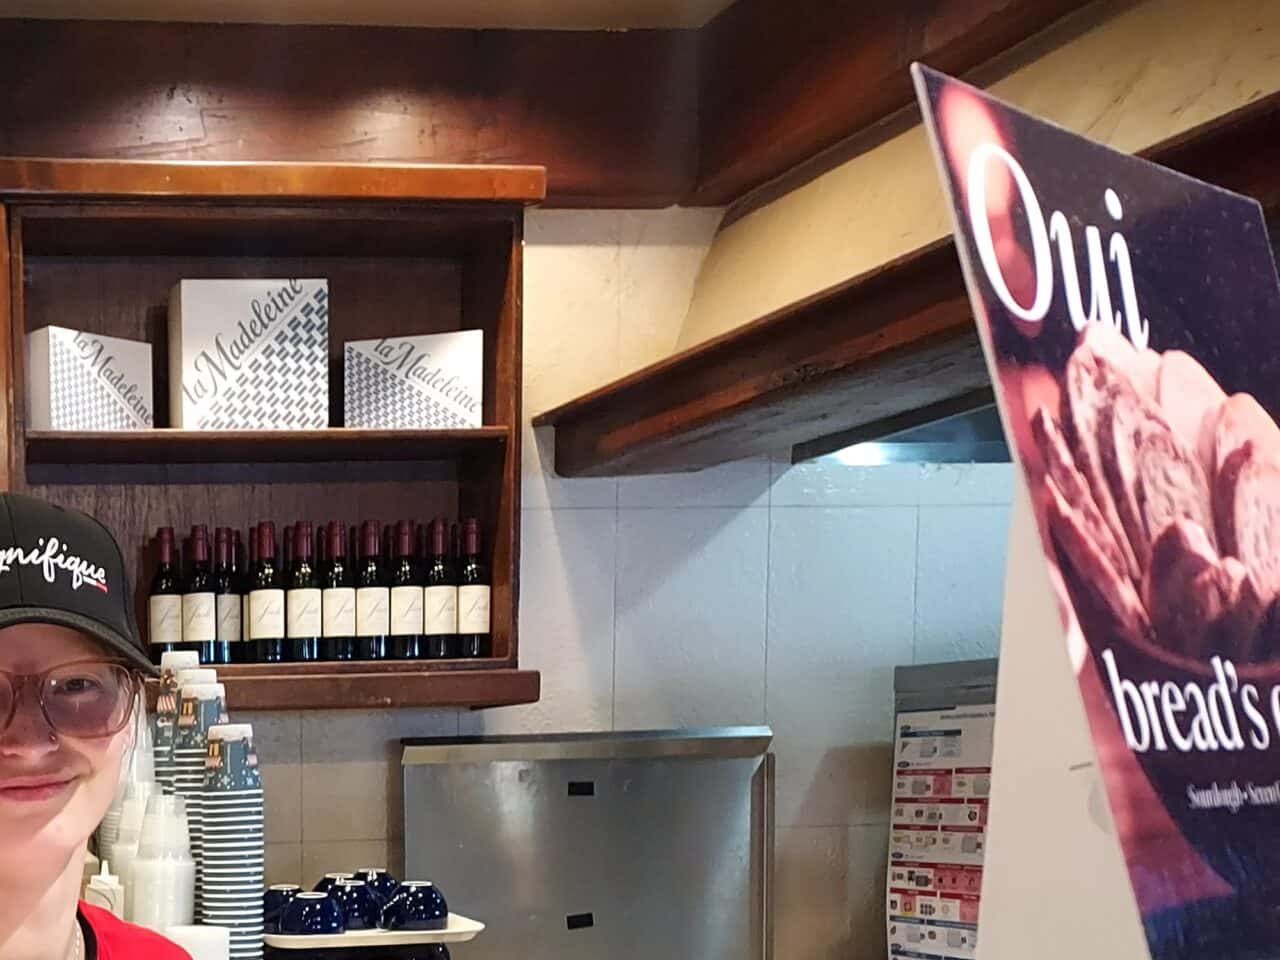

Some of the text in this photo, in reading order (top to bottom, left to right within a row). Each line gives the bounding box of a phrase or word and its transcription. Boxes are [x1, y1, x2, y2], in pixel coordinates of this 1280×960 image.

[968, 143, 1149, 350] Oui
[80, 339, 152, 425] Madeleine
[194, 279, 304, 399] Madeleine
[1101, 648, 1270, 752] bread's
